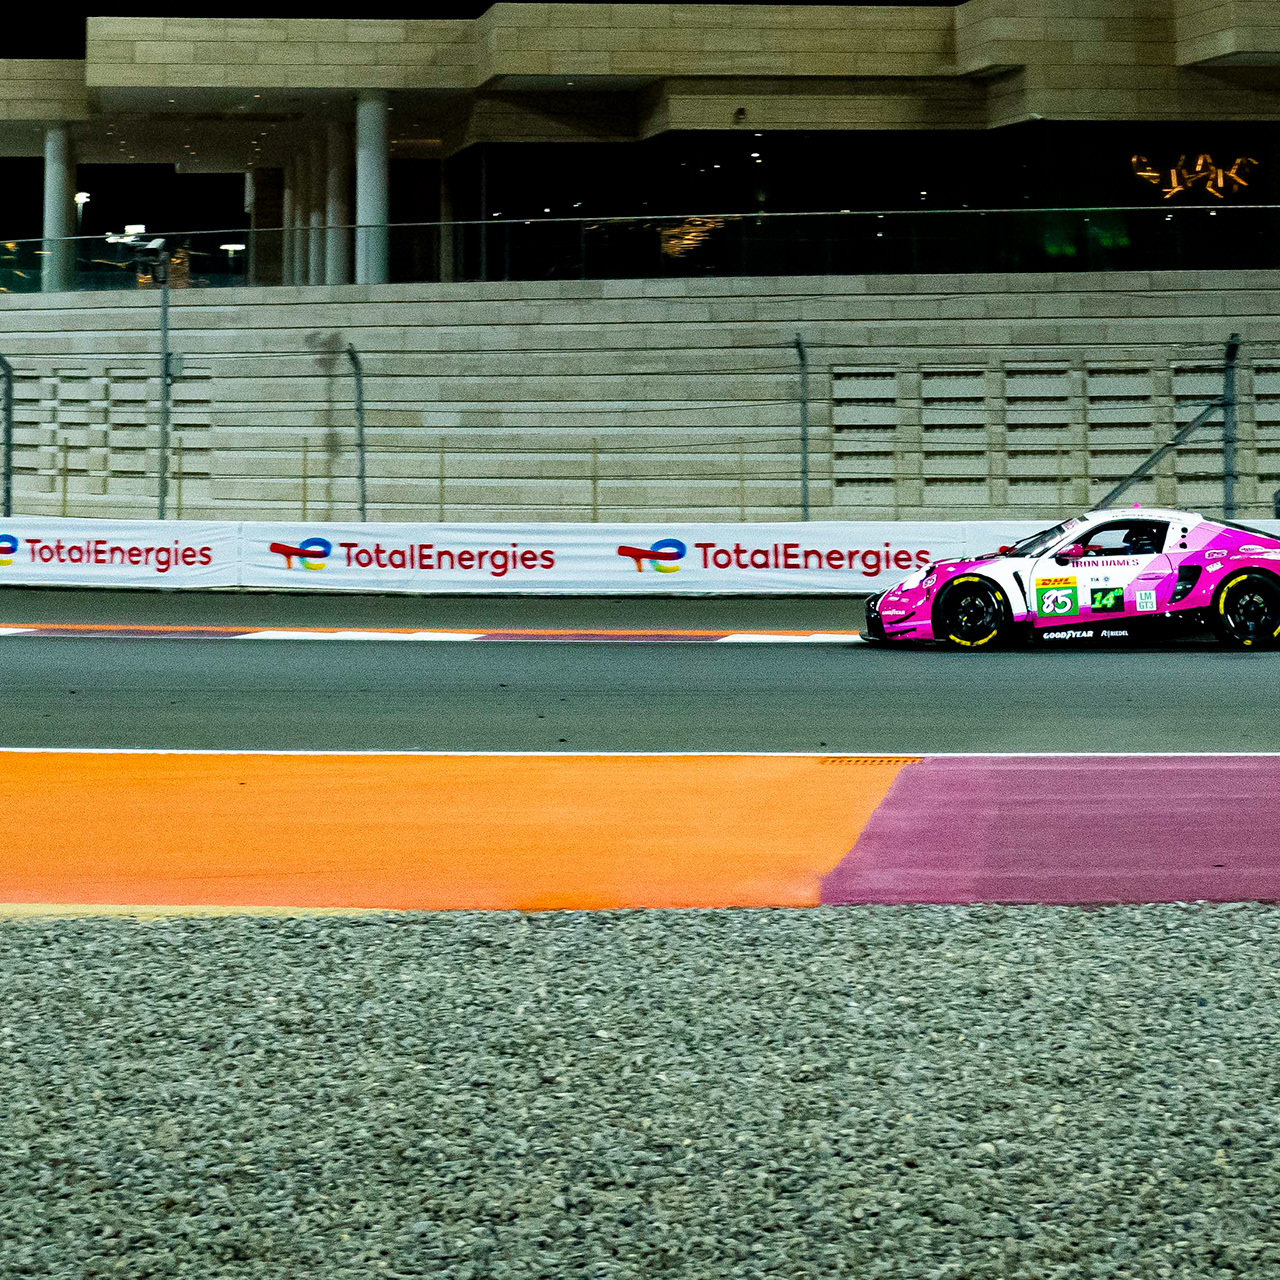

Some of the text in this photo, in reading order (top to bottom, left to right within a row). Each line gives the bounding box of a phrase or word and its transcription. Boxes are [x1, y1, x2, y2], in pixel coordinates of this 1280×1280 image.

[24, 538, 213, 573] TotalEnergies
[338, 542, 556, 578] TotalEnergies
[693, 542, 931, 578] TotalEnergies
[1071, 559, 1139, 568] IRON DAMES
[1041, 577, 1071, 585] DHL
[1041, 588, 1073, 614] 85
[1140, 592, 1152, 600] LM
[1139, 601, 1154, 610] GT3
[1043, 630, 1094, 640] GOODYEAR
